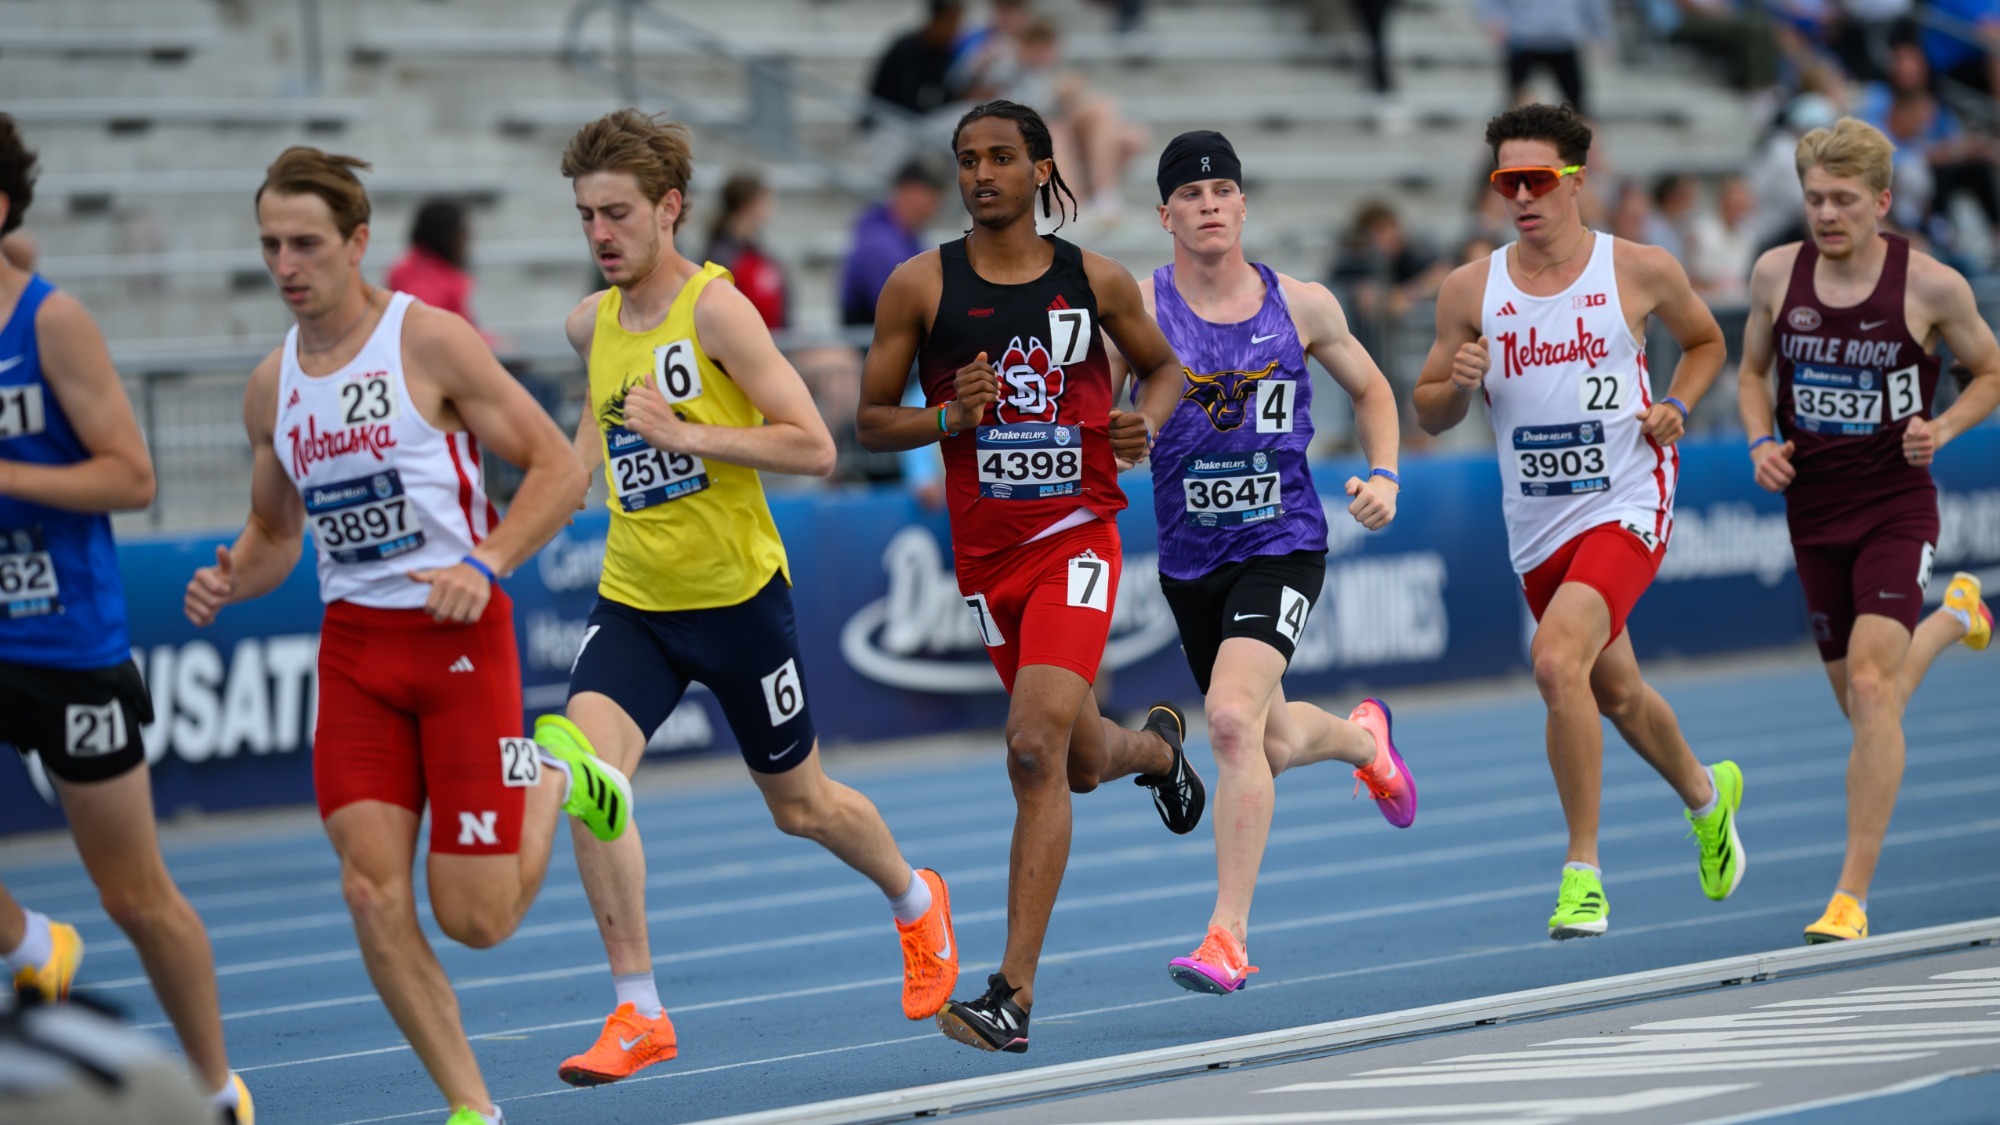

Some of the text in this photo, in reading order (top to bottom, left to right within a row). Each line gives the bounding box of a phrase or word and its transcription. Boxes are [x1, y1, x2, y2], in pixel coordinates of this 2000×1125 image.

[1058, 312, 1082, 363] 7
[1496, 316, 1609, 379] Nebraska
[1781, 333, 1903, 368] LITTLE ROCK
[664, 344, 692, 398] 6
[342, 378, 391, 425] 23
[1262, 383, 1287, 430] 4
[1586, 375, 1620, 411] 22
[1798, 389, 1879, 420] 3537
[1896, 372, 1914, 415] 3
[287, 413, 398, 480] Nebraska
[987, 428, 1047, 440] Drake RELAYS
[1523, 430, 1549, 442] Drake
[617, 450, 694, 492] 2515
[982, 450, 1078, 481] 4398
[1194, 459, 1246, 470] Drake RELAYS
[1520, 447, 1605, 478] 3903
[1189, 475, 1277, 509] 3647
[318, 500, 406, 547] 3897
[1077, 561, 1102, 605] 7
[965, 598, 991, 644] 7
[1284, 596, 1305, 640] 4
[773, 669, 796, 717] 6
[73, 709, 118, 752] 21
[504, 741, 537, 782] 23
[458, 810, 498, 846] N
